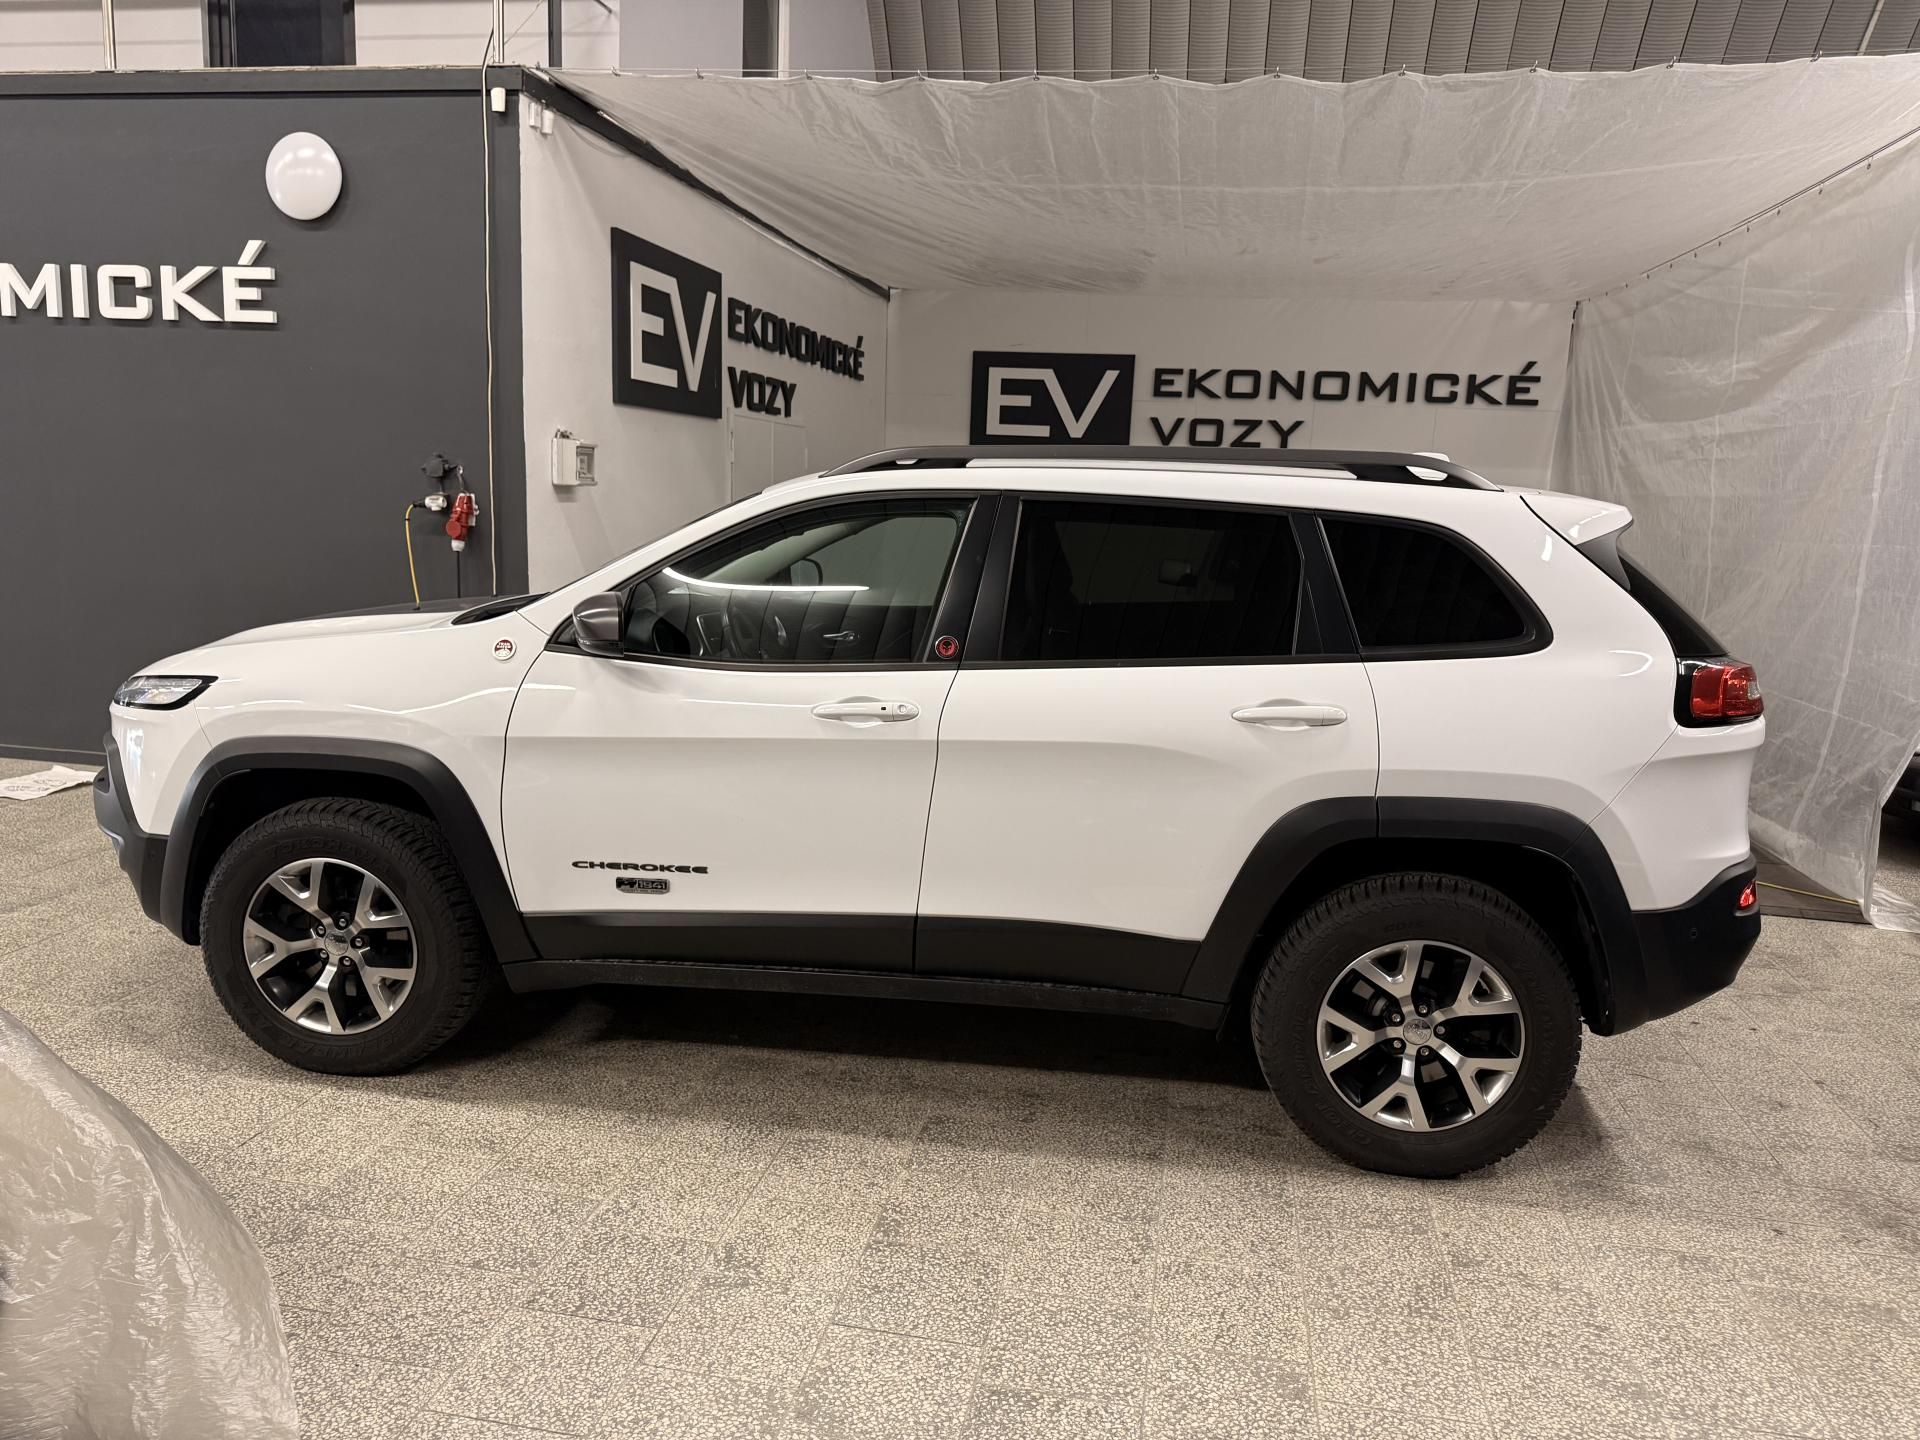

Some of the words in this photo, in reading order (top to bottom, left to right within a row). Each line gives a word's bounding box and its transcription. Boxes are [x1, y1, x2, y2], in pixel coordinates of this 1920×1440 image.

[0, 239, 278, 324] MICKÉ
[630, 261, 717, 392] EV
[728, 297, 865, 381] EKONOMICKÉ
[728, 366, 797, 418] VOZY
[986, 366, 1121, 439] EV
[1153, 361, 1541, 407] EKONOMICKÉ
[1150, 417, 1305, 449] VOZY
[571, 860, 709, 874] CHEROKEE
